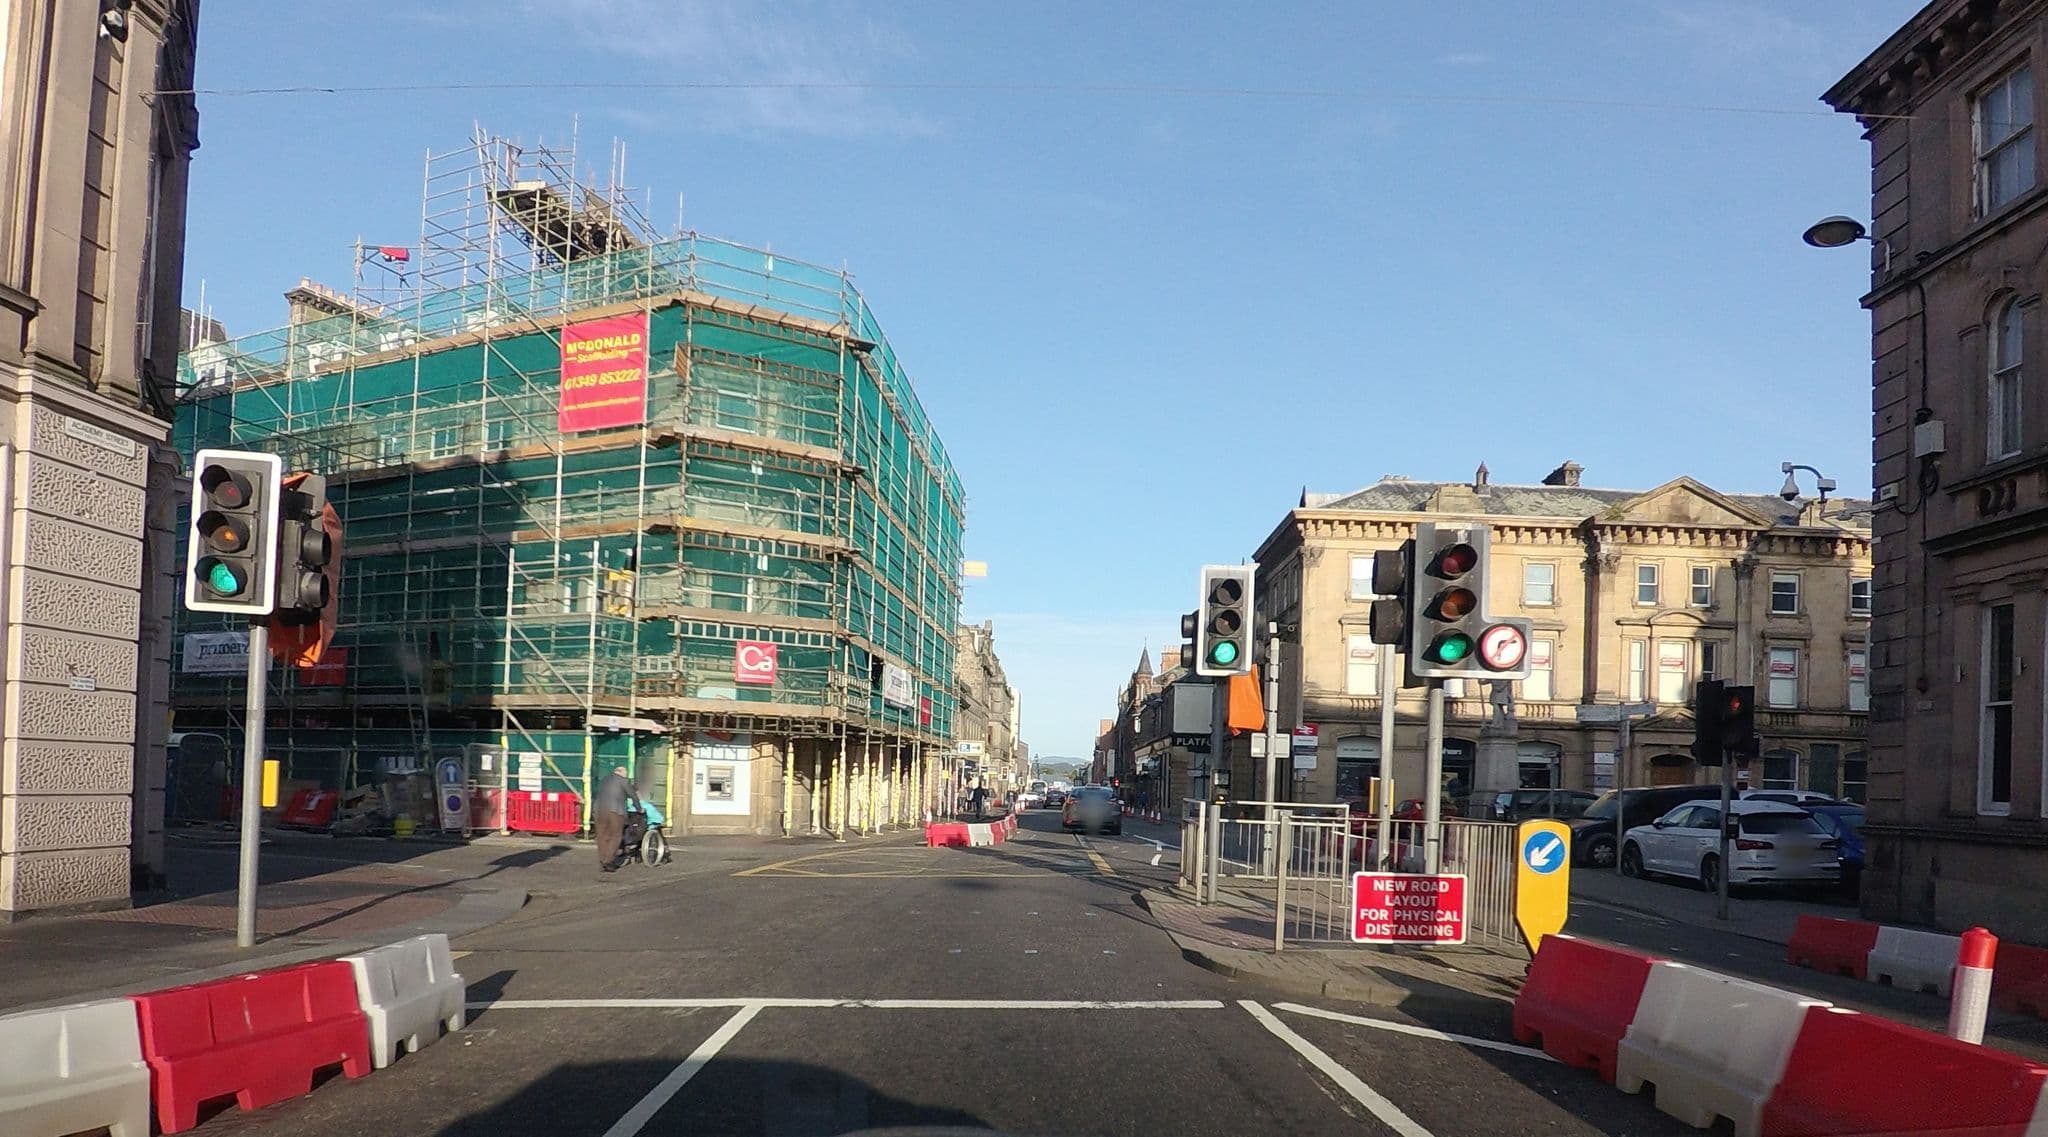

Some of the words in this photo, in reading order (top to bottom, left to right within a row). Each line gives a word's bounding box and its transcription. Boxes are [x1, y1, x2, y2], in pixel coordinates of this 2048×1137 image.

[564, 374, 597, 390] 01349
[599, 368, 641, 385] 853222
[105, 432, 129, 447] STREET
[1373, 879, 1407, 892] NEW
[1411, 880, 1450, 893] ROAD
[1385, 894, 1438, 907] LAYOUT
[1360, 908, 1389, 921] FOR
[1393, 909, 1461, 922] PHYSICAL
[1365, 923, 1454, 936] DISTANCING
